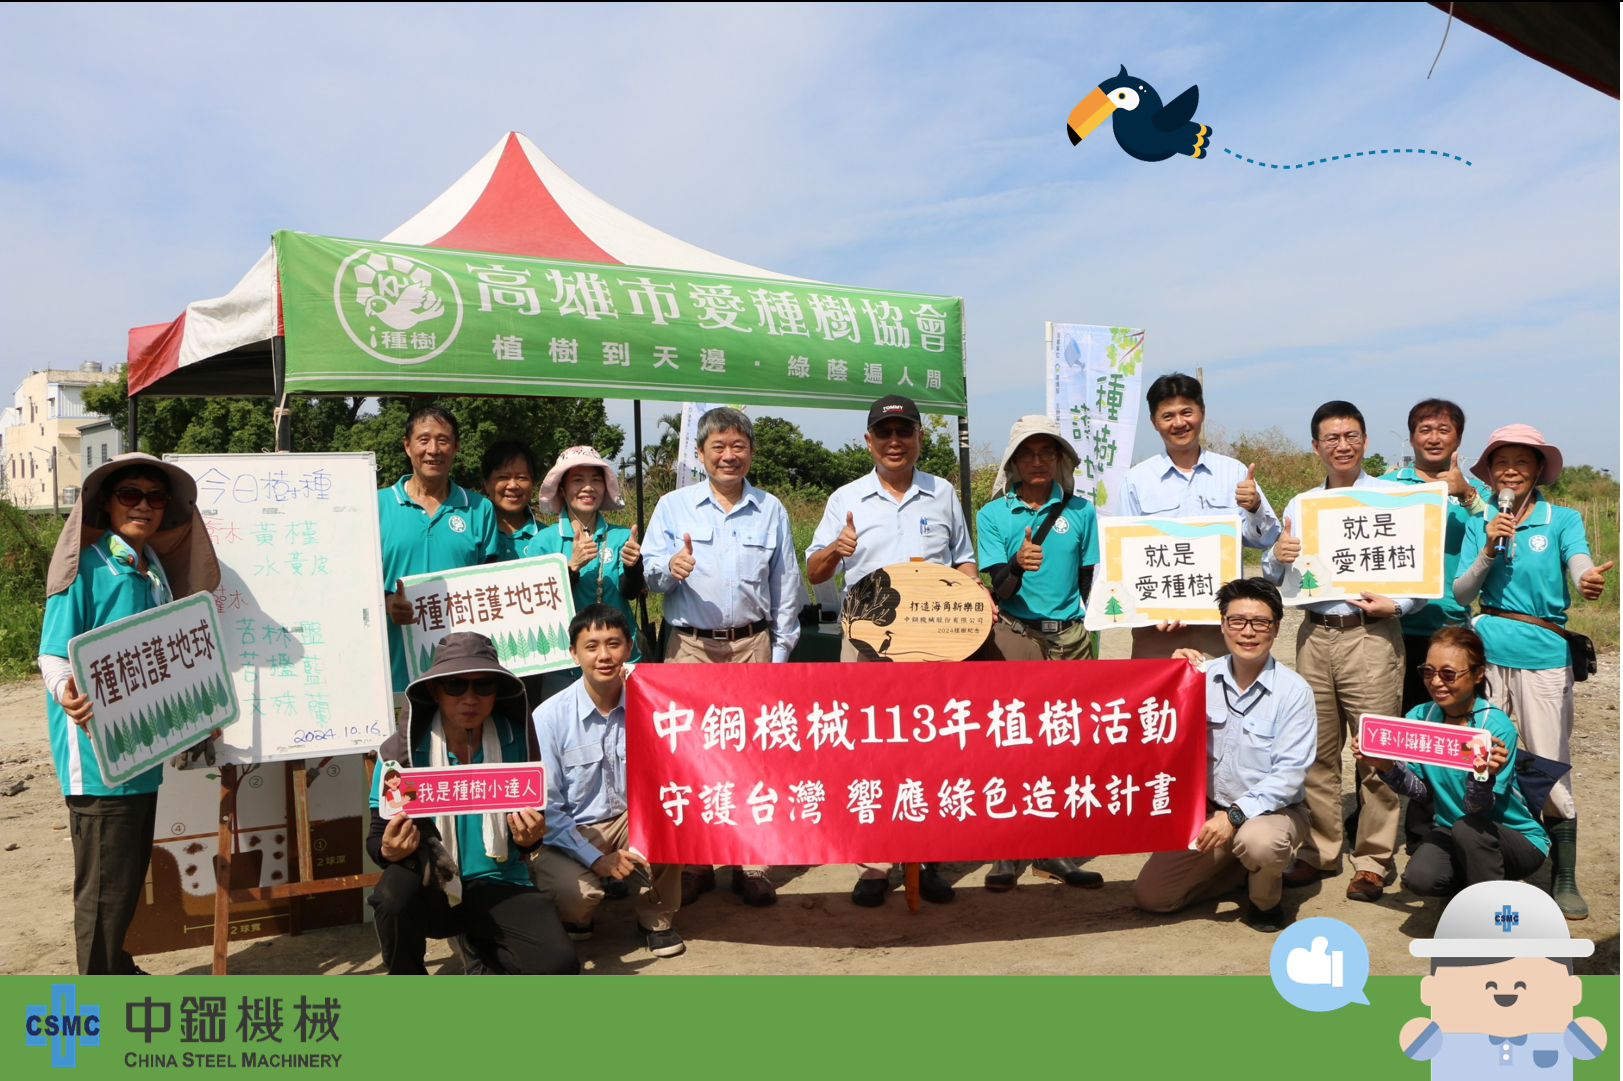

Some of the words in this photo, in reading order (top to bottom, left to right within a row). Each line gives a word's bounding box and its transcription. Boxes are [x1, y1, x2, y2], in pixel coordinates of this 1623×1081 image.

[466, 263, 947, 353] 高雄市愛種樹協會
[1093, 374, 1125, 472] 種樹
[1344, 513, 1397, 540] 就是
[1144, 543, 1196, 568] 就是
[1331, 545, 1416, 575] 愛種樹
[1135, 573, 1213, 601] 愛種樹
[415, 576, 563, 632] 種樹護地球
[909, 601, 984, 613] 打造海角新樂園
[90, 622, 216, 709] 種樹護地球
[653, 697, 1178, 754] 中鋼機械113年植樹活動
[1367, 727, 1460, 757] 我是種樹小達人
[418, 778, 537, 804] 我是種樹小達人
[659, 780, 826, 827] 守護台灣
[846, 772, 1177, 825] 響應綠色造林計畫
